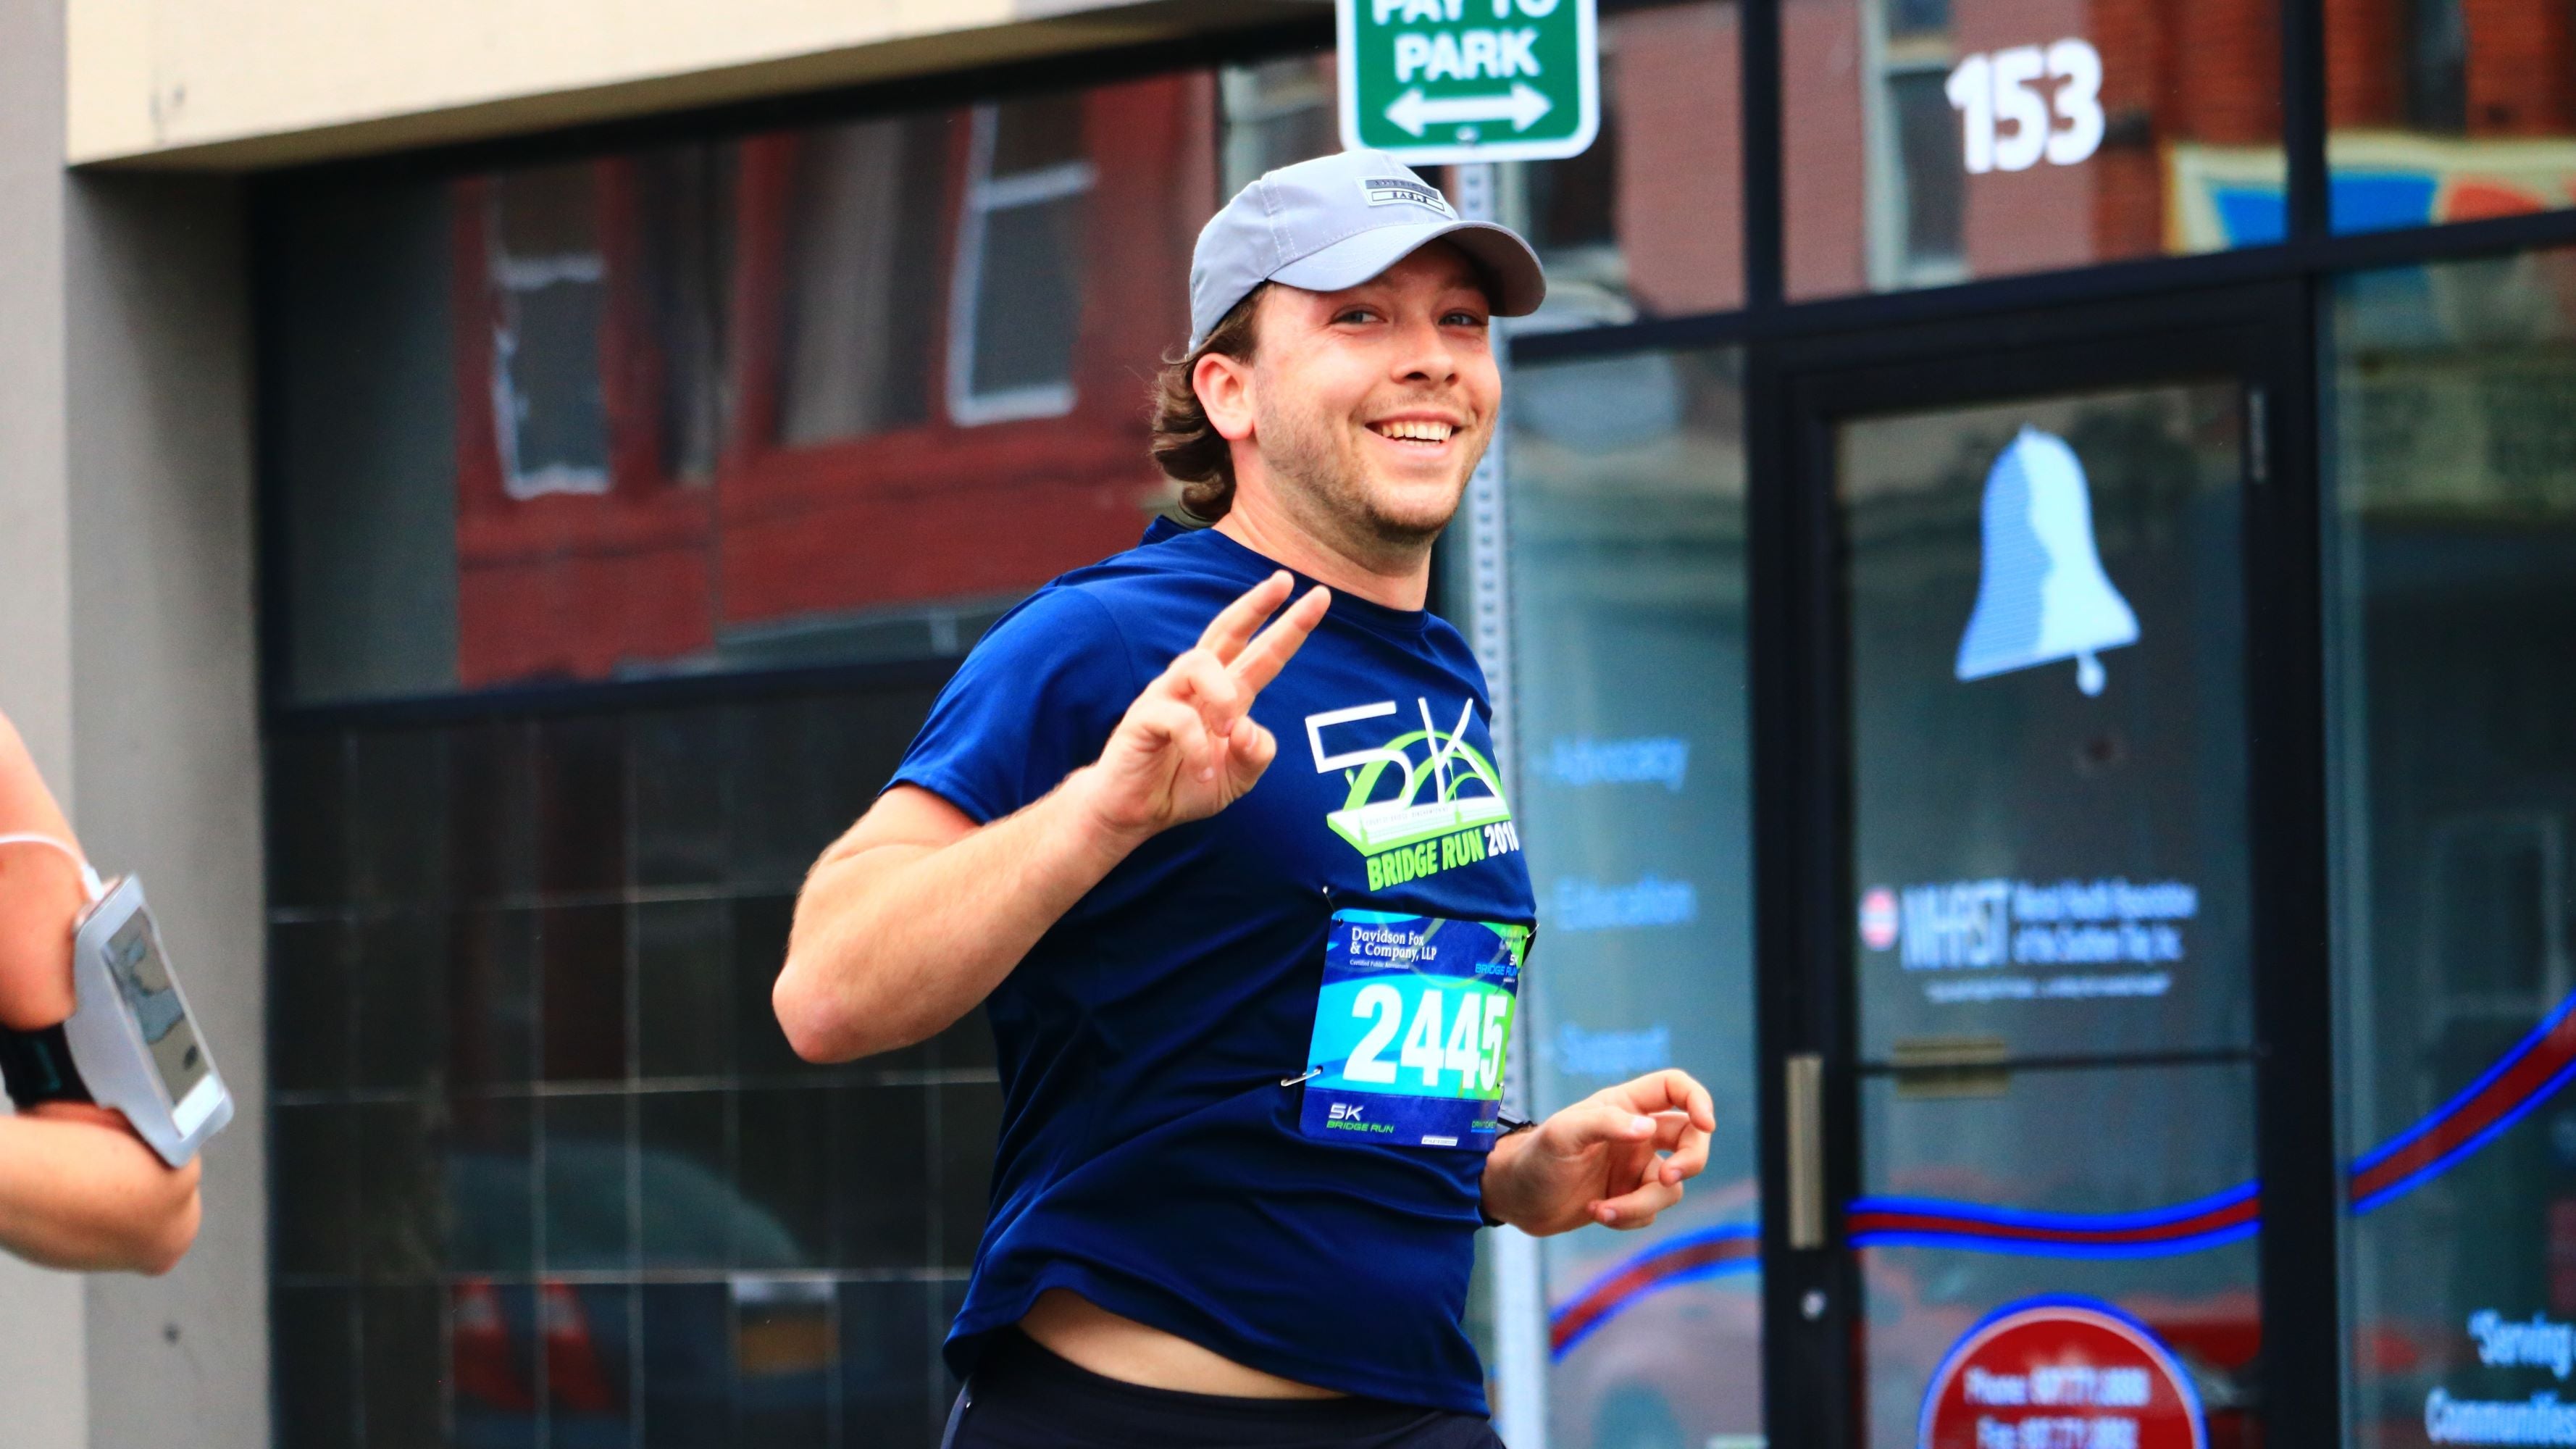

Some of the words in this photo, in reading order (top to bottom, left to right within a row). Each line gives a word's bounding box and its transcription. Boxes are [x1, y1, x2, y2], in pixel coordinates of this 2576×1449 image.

[1394, 26, 1543, 83] PARK
[1944, 36, 2106, 175] 153
[1305, 696, 1504, 806] 5K
[1366, 840, 1439, 892] BRIDGE
[1441, 828, 1486, 871] RUN
[1350, 941, 1362, 955] &
[1365, 942, 1420, 963] Company,
[1421, 945, 1438, 961] LLP
[1351, 927, 1406, 945] Davidson
[1408, 930, 1425, 946] Fox
[1475, 963, 1505, 976] BRIDGE
[1342, 982, 1508, 1093] 2445
[1326, 1119, 1369, 1132] BRIDGE
[1370, 1124, 1394, 1134] RUN
[1329, 1102, 1364, 1122] 5K
